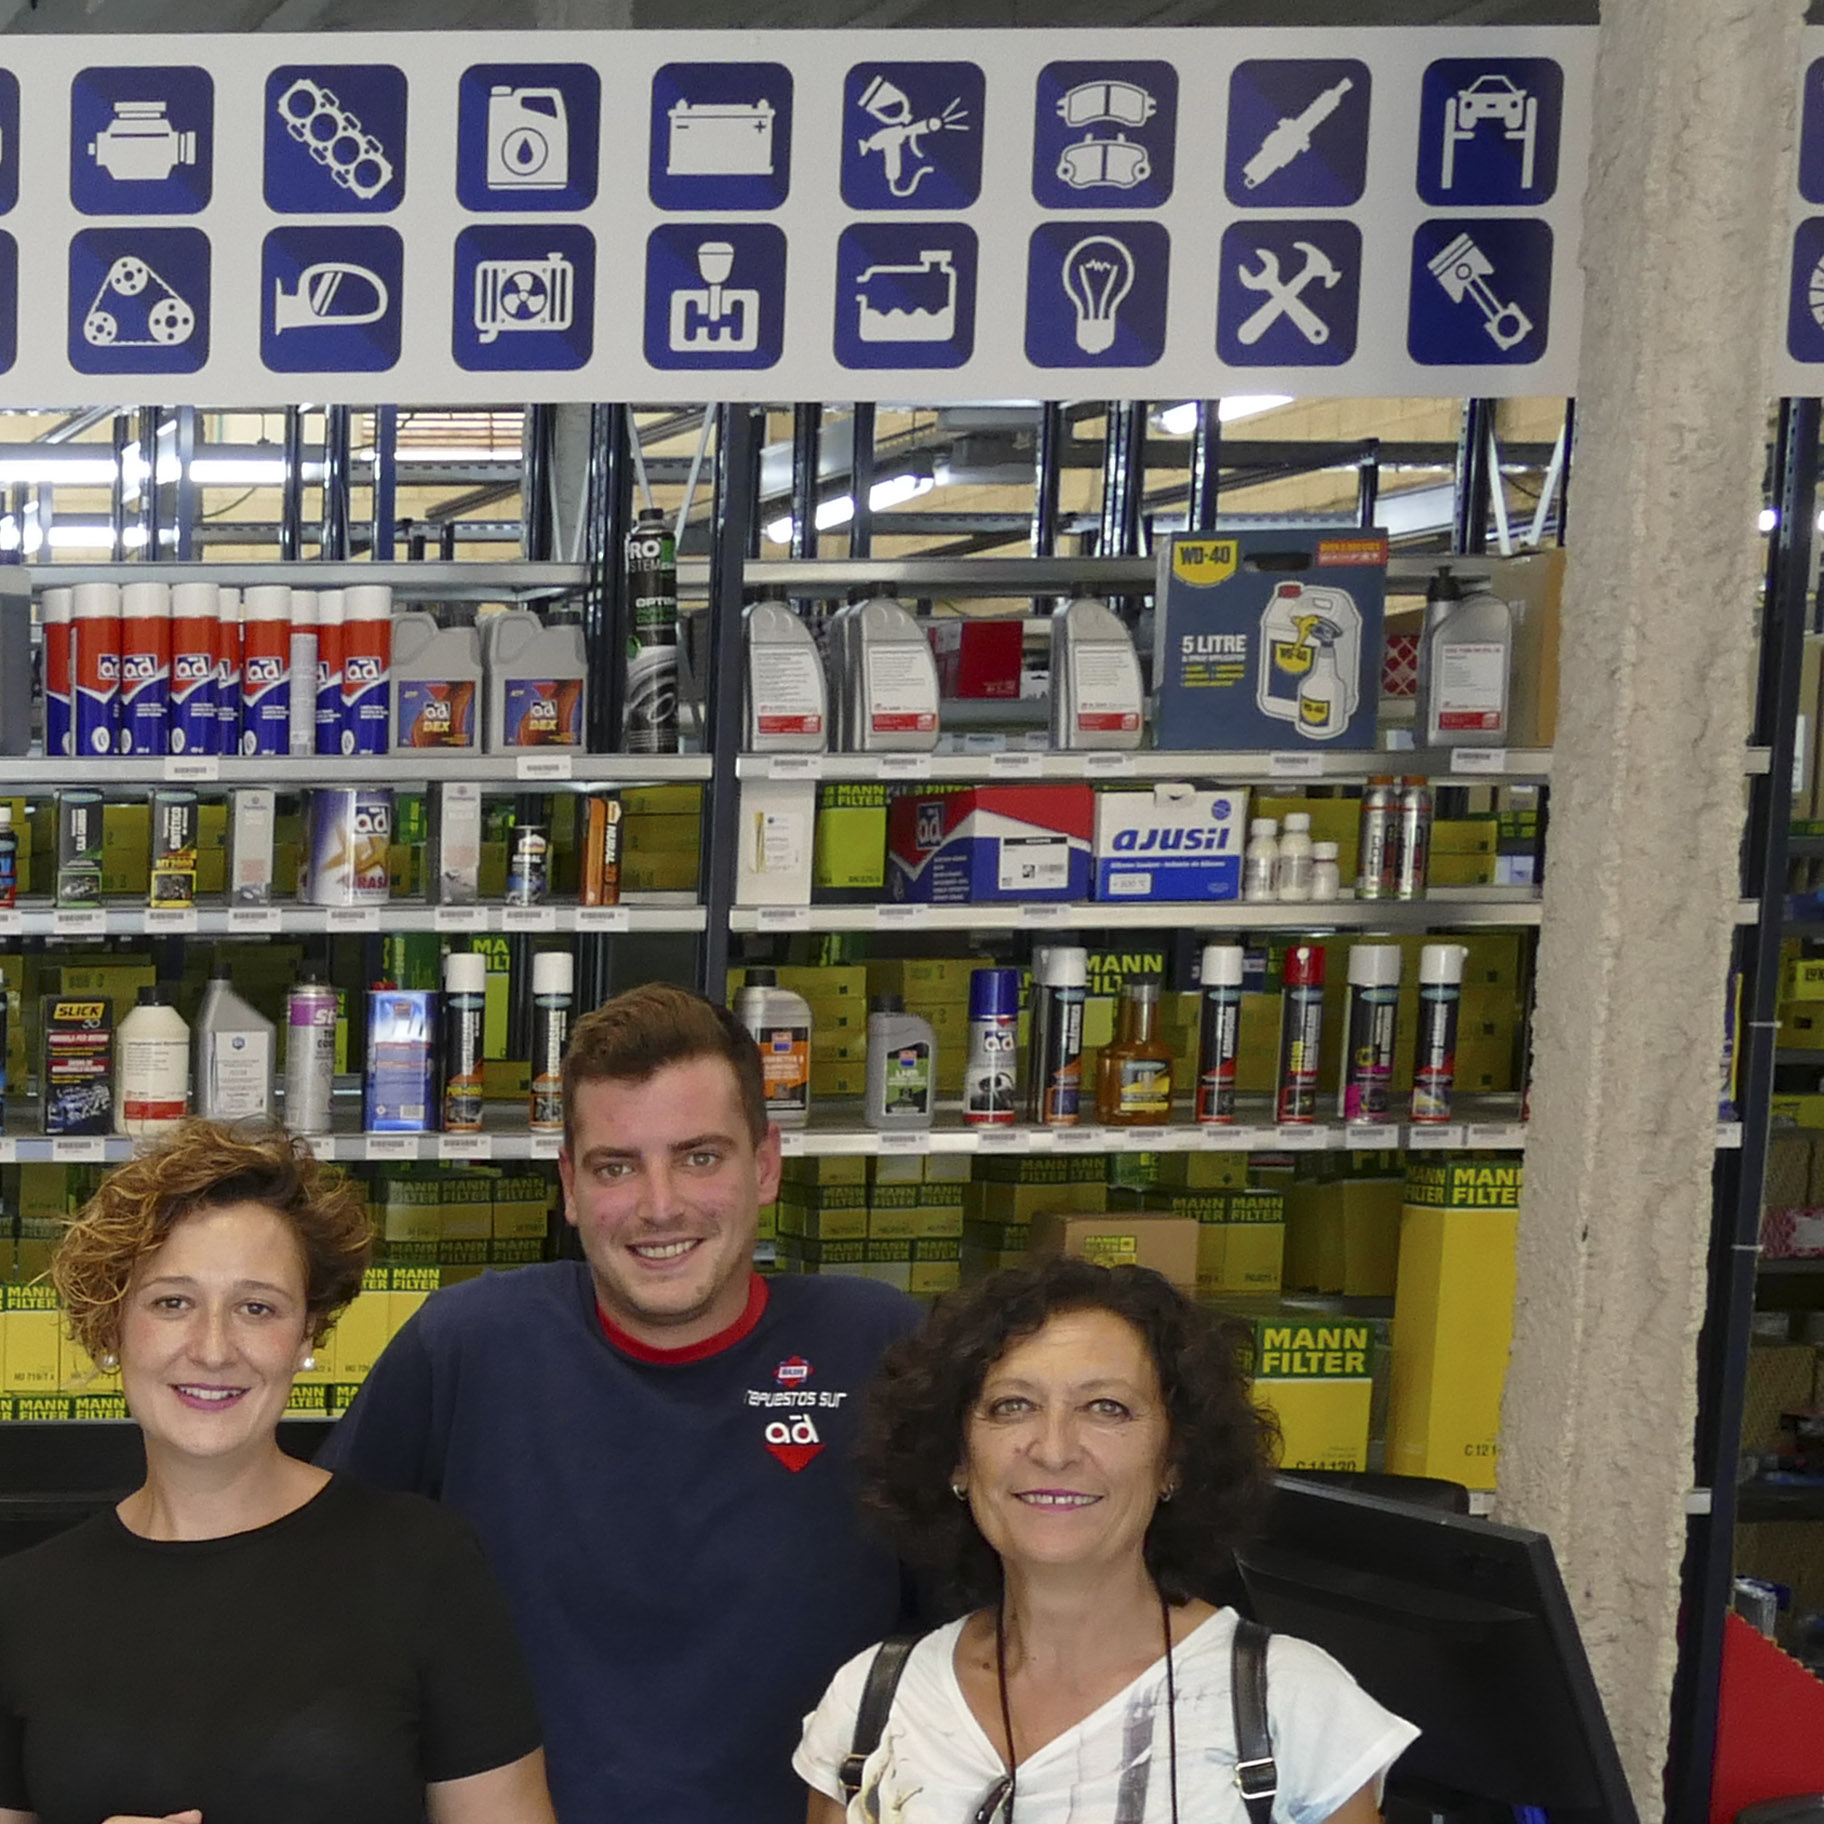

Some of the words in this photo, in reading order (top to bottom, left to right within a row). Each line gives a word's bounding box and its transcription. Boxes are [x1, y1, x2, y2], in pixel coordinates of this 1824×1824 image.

[1180, 546, 1231, 565] WD-40
[1182, 636, 1192, 653] 5
[1196, 634, 1247, 653] LITRE
[124, 655, 155, 677] ad
[176, 656, 209, 678] ad
[248, 660, 280, 680] ad
[347, 659, 380, 680] ad
[423, 721, 450, 732] DEX
[530, 719, 557, 731] DEX
[838, 785, 885, 795] MANN
[838, 796, 885, 806] FILTER
[605, 825, 617, 864] NURAL
[1112, 827, 1231, 852] ajusil
[1084, 954, 1163, 972] MANN
[58, 1005, 100, 1016] SLICK
[985, 1031, 1015, 1052] ad
[443, 1181, 490, 1190] MANN
[496, 1179, 545, 1189] MANN
[443, 1190, 490, 1201] FILTER
[496, 1189, 545, 1199] FILTER
[1173, 1198, 1225, 1209] MANN
[1232, 1198, 1284, 1209] MANN
[1232, 1210, 1284, 1220] FILTER
[393, 1268, 440, 1279] MANN
[393, 1280, 440, 1290] FILTER
[7, 1286, 57, 1298] MANN
[7, 1298, 57, 1308] FILTER
[1263, 1328, 1368, 1350] MANN
[1262, 1352, 1365, 1374] FILTER
[19, 1401, 70, 1410] MANN
[75, 1399, 126, 1410] MANN
[19, 1412, 70, 1420] FILTER
[75, 1410, 126, 1420] FILTER
[765, 1413, 820, 1444] ad
